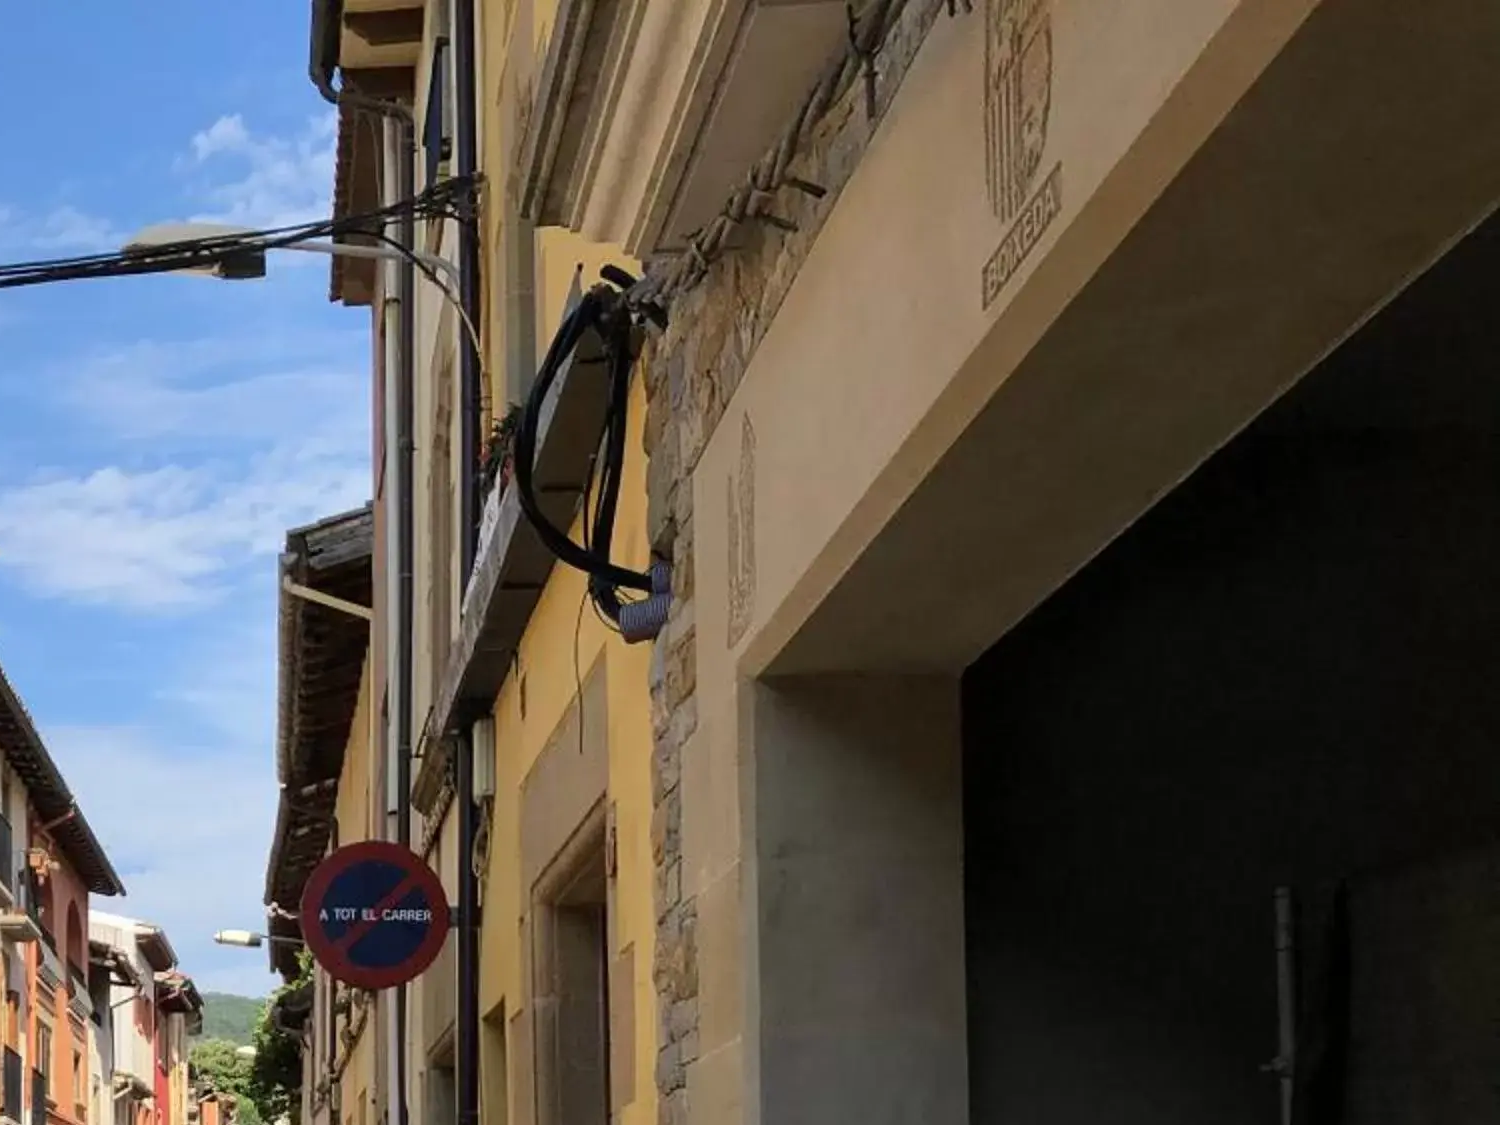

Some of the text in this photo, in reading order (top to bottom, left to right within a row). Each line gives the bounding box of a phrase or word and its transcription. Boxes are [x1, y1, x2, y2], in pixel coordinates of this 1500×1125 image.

[319, 908, 432, 921] A TOT EL CARRER
